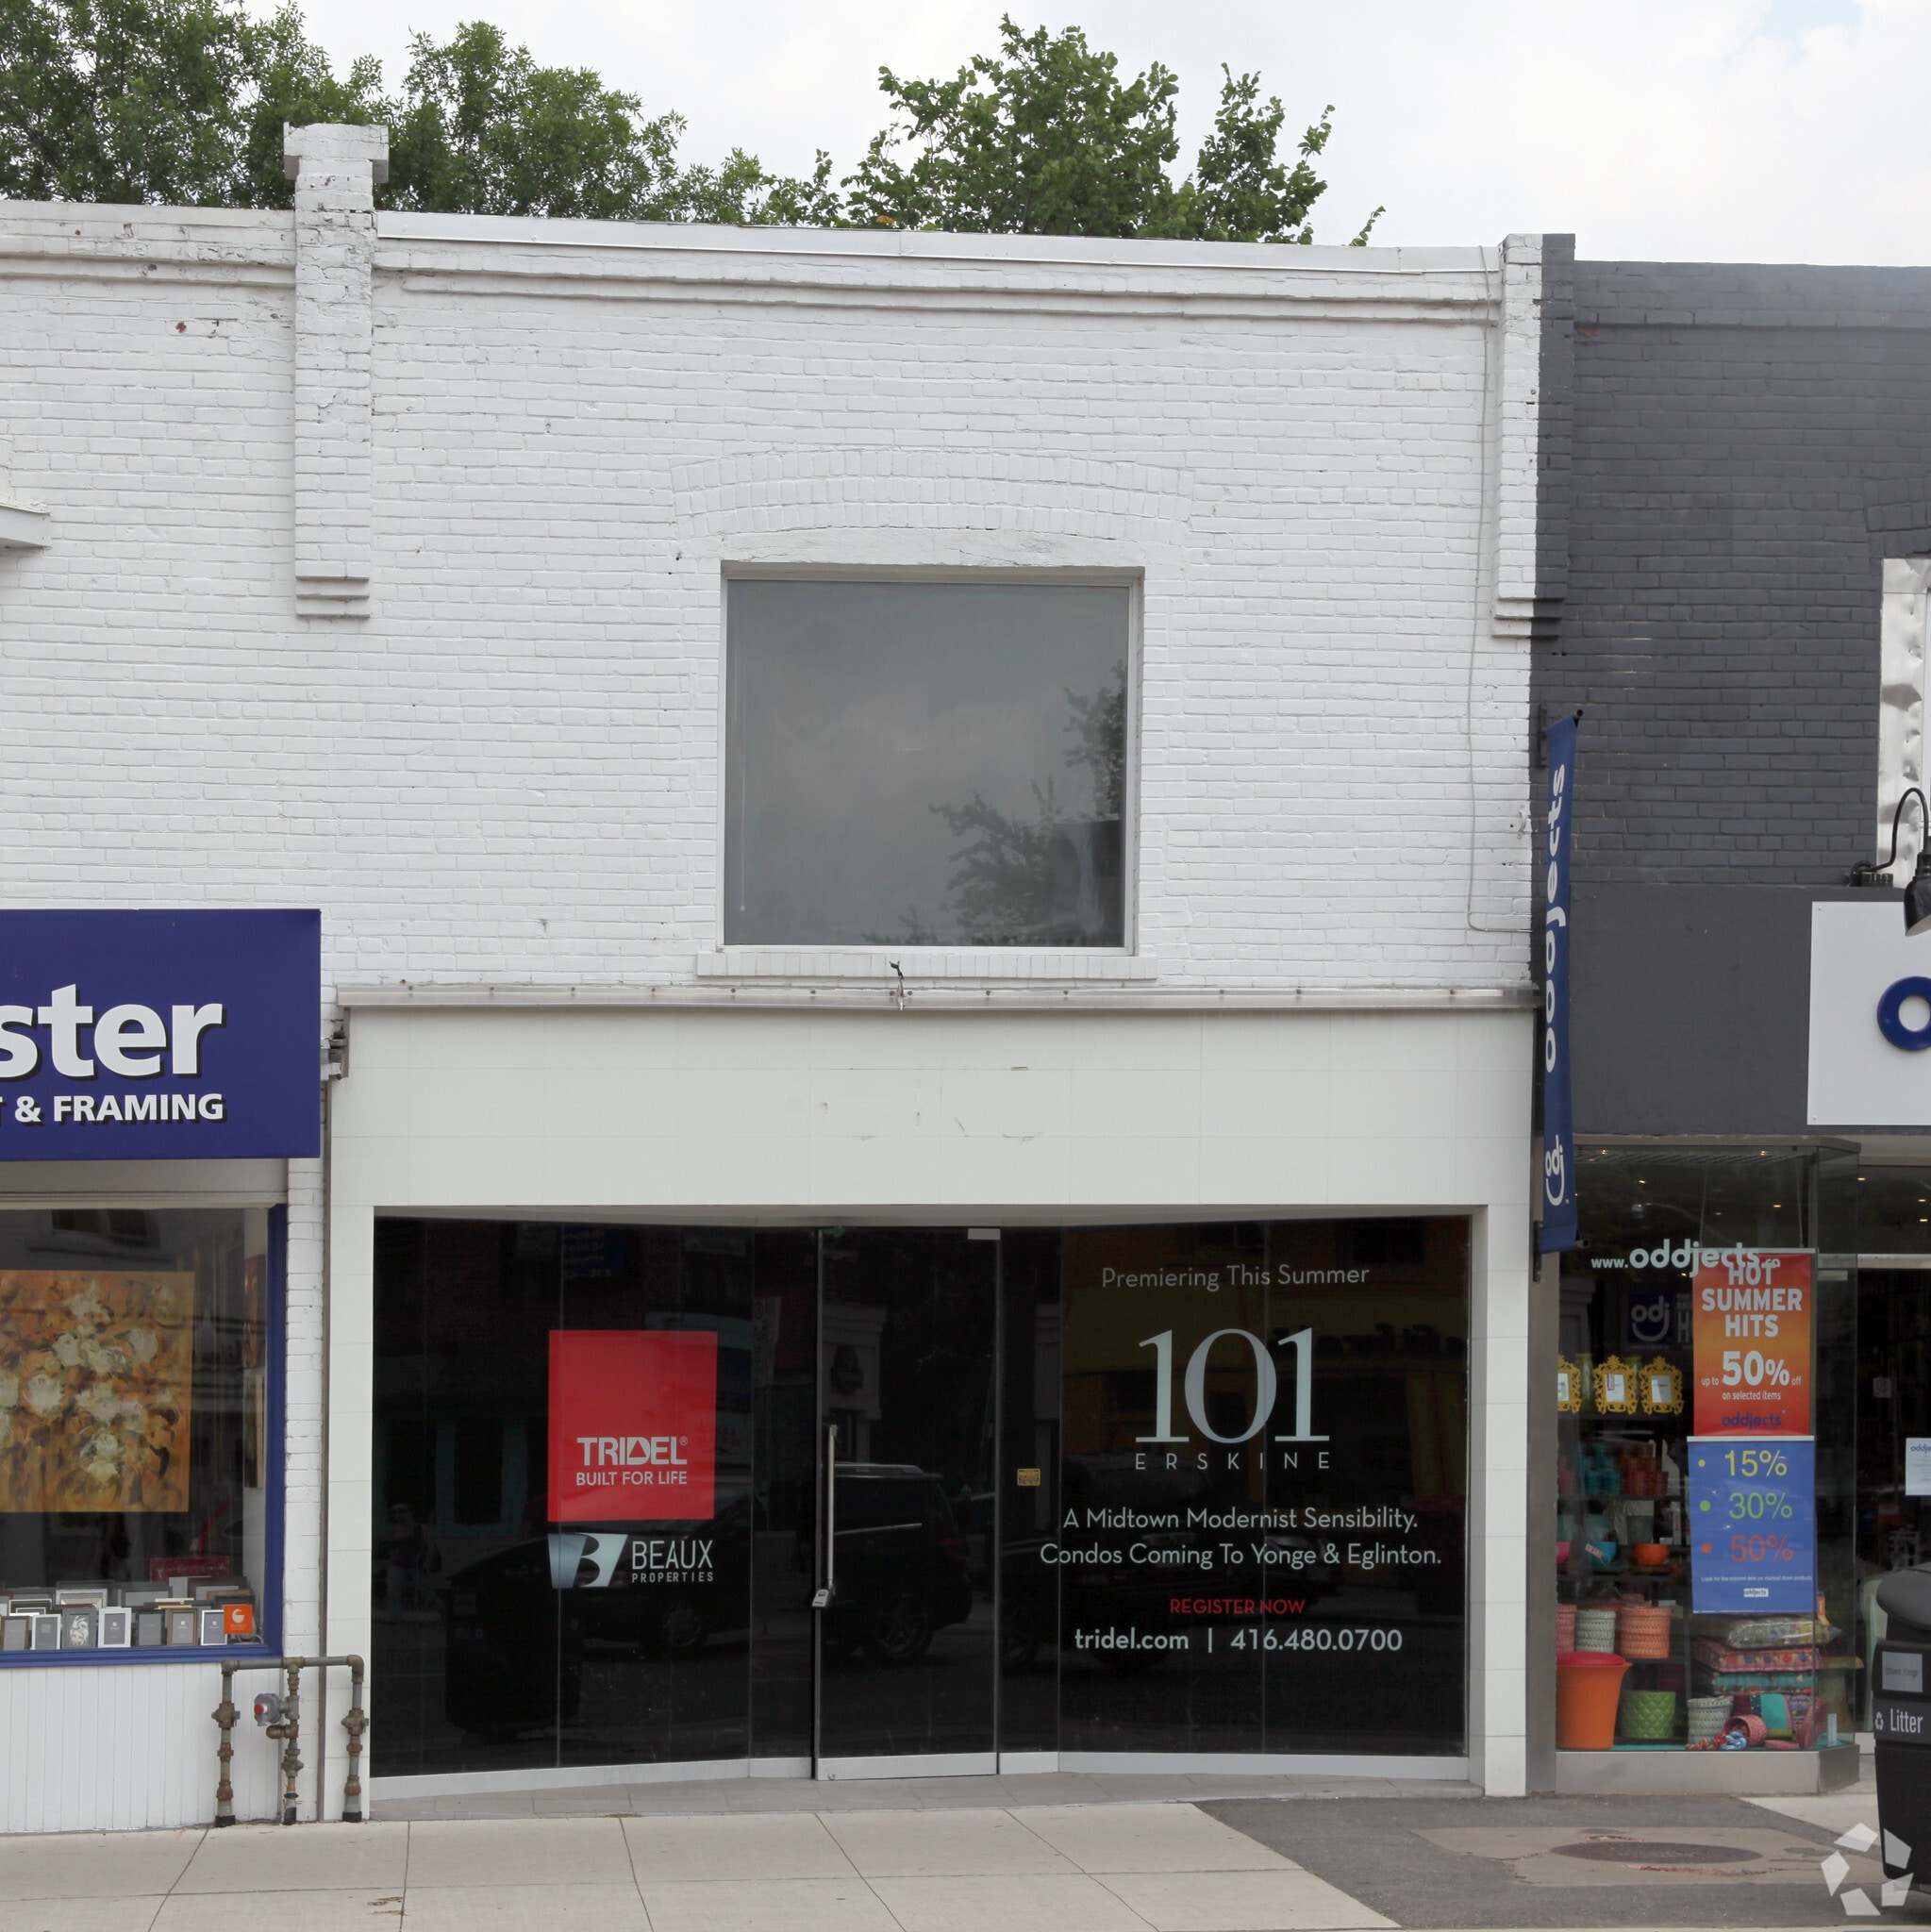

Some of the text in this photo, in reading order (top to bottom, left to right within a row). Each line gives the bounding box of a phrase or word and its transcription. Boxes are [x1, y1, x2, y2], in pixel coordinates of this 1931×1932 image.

[15, 1093, 223, 1122] & FRAMING
[1103, 1264, 1370, 1291] Premiering This Summer
[1728, 1263, 1773, 1285] HOT
[1702, 1289, 1802, 1310] SUMMER
[1725, 1315, 1778, 1337] HITS
[1702, 1351, 1801, 1387] up to 50% off
[1136, 1328, 1329, 1443] 101
[1733, 1391, 1760, 1400] selected
[1762, 1391, 1781, 1400] items
[1722, 1411, 1781, 1430] oddjects
[1136, 1452, 1329, 1470] ERSKINE
[1725, 1450, 1788, 1476] 15%
[576, 1471, 687, 1486] BUILT FOR LIFE
[1729, 1492, 1792, 1519] 30%
[1064, 1507, 1417, 1533] A Midtown Modernist Sensibility.
[632, 1541, 712, 1569] BEAUX
[1040, 1542, 1440, 1570] Condos Coming To Yonge & Eglinton.
[1731, 1535, 1794, 1562] 50%
[632, 1572, 712, 1583] PROPERTIES
[1171, 1598, 1305, 1614] REGISTER NOW
[1075, 1627, 1189, 1649] tridel.com
[1231, 1629, 1402, 1650] 416.480.0700
[1890, 1708, 1923, 1733] Litter
